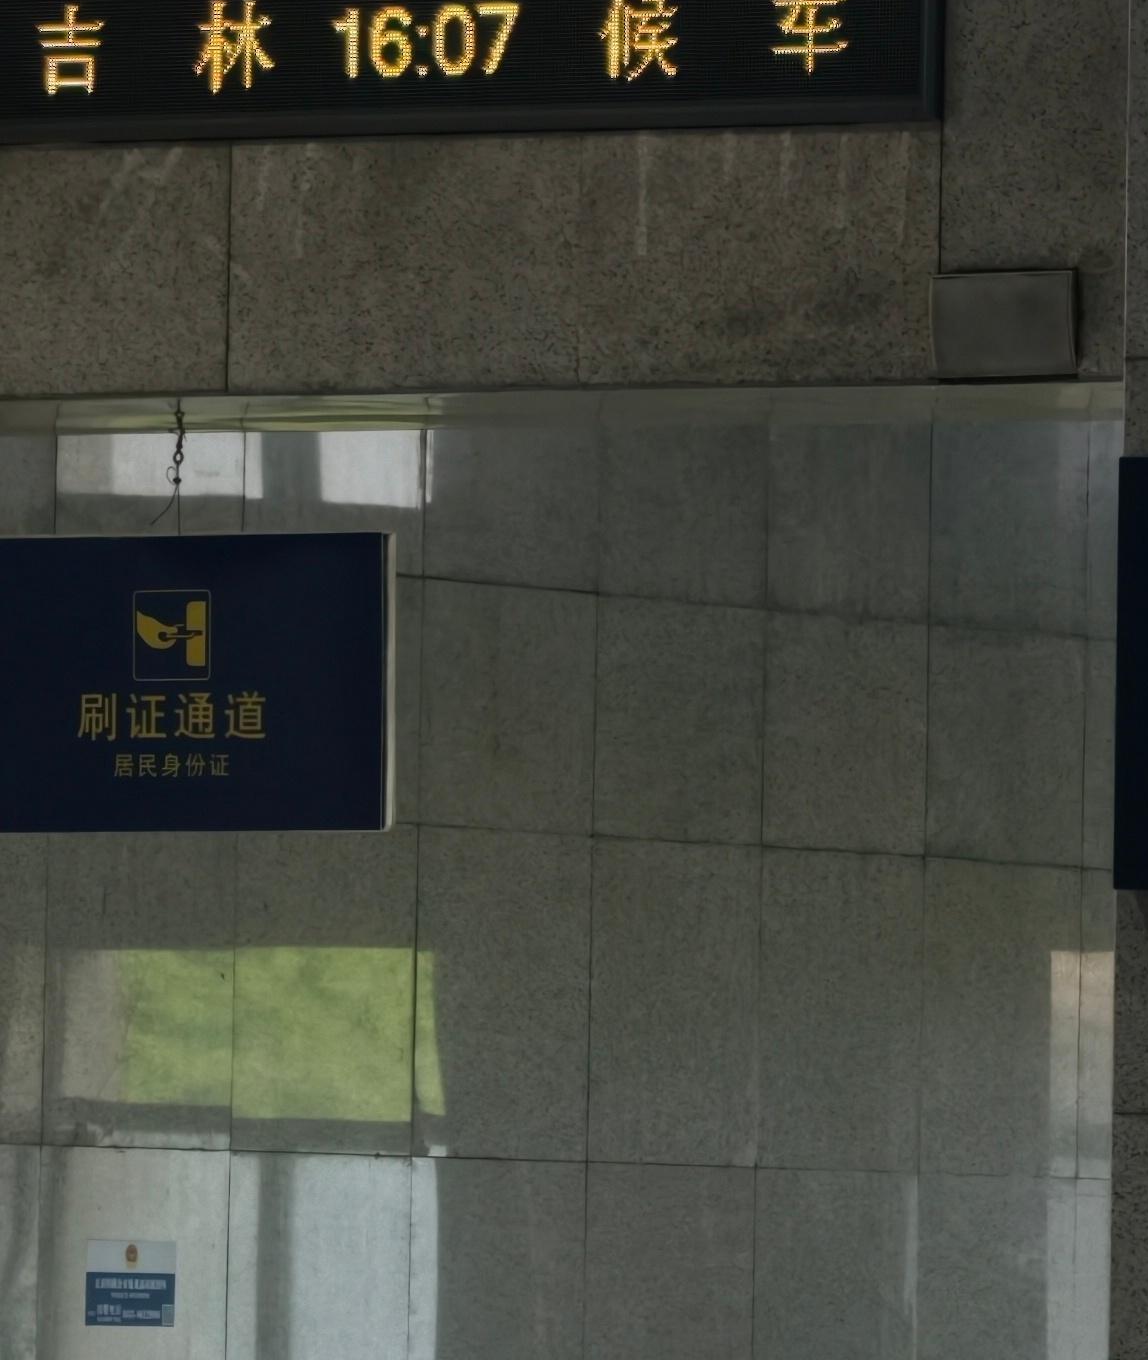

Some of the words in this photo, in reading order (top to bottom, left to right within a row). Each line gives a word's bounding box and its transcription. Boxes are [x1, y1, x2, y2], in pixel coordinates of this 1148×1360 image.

[37, 0, 276, 95] 吉林
[334, 1, 520, 79] 16:07
[77, 690, 266, 741] 刷证通道
[113, 752, 230, 778] 居民身份证
